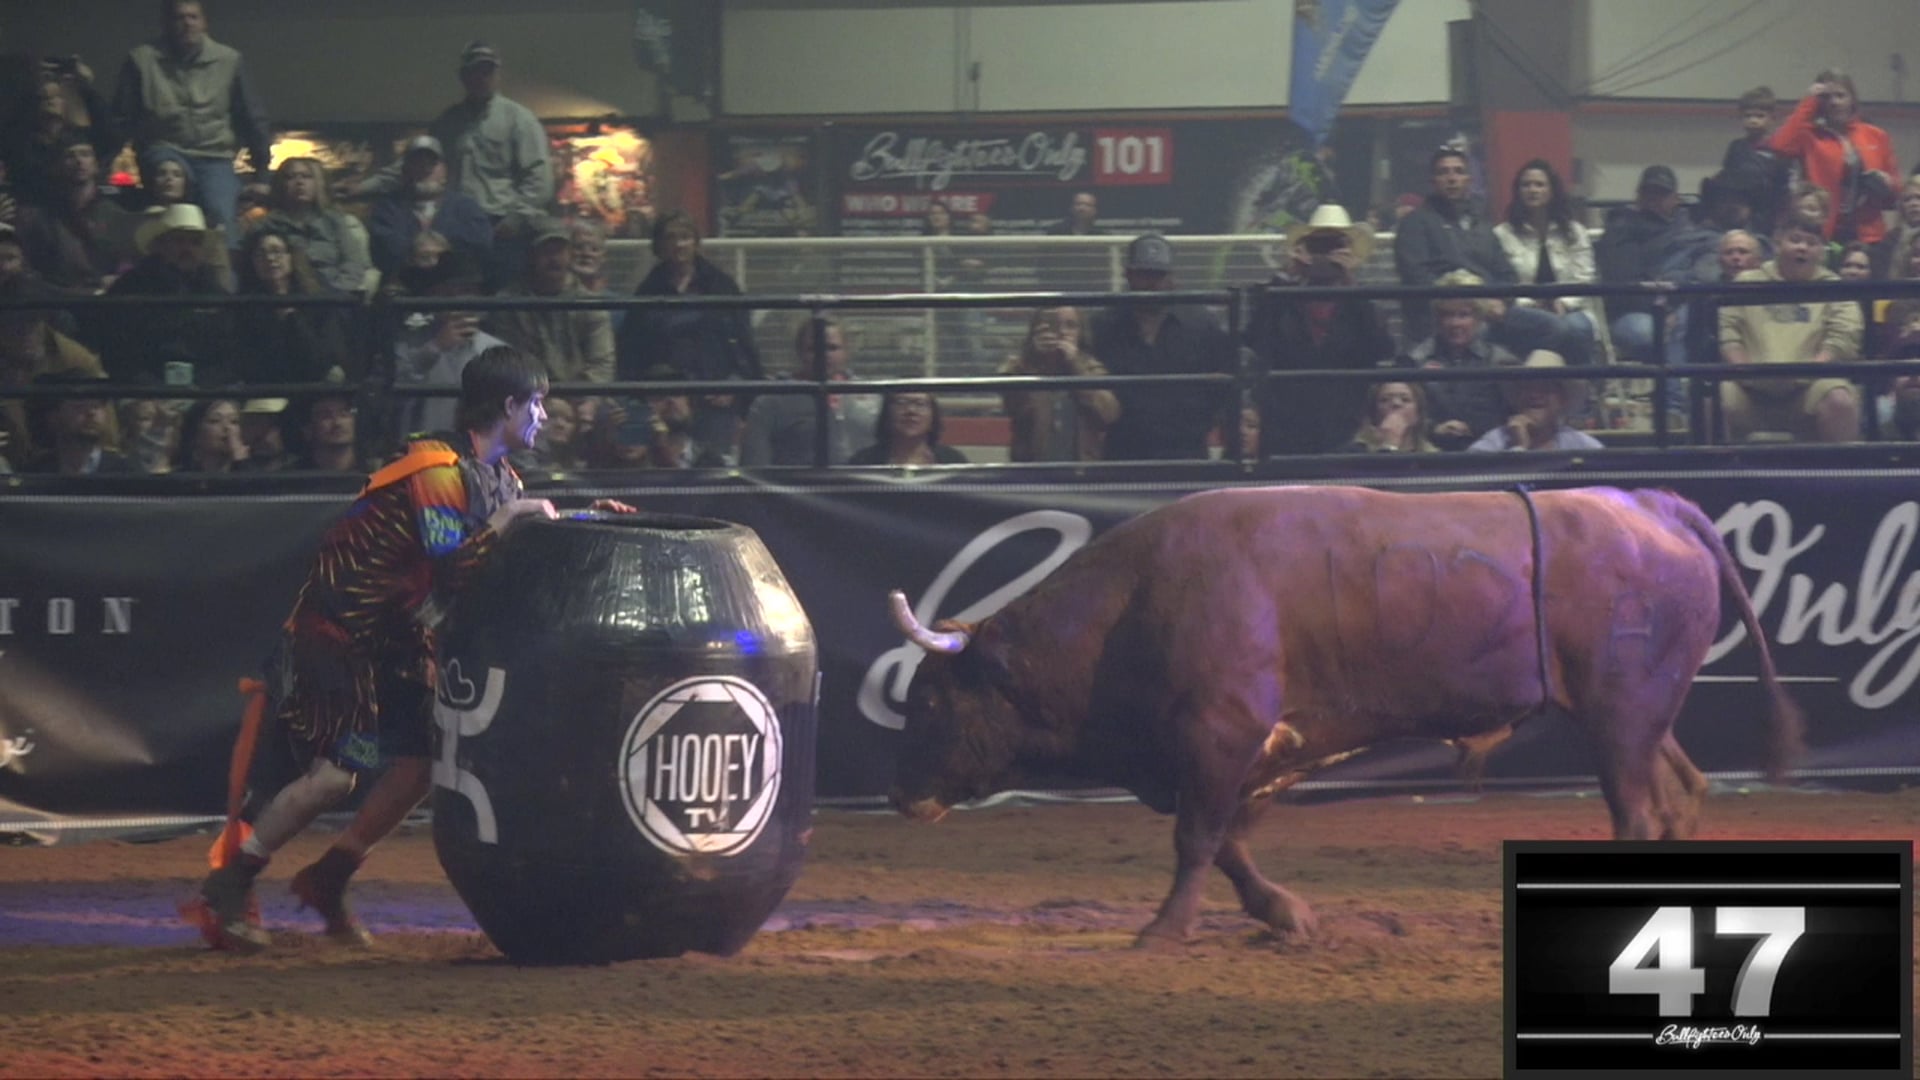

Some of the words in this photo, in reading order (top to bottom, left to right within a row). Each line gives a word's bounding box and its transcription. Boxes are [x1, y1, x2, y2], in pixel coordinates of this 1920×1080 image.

[1016, 132, 1087, 181] Only
[1096, 136, 1164, 174] 101
[654, 733, 760, 802] HOOEY
[684, 807, 729, 829] TV
